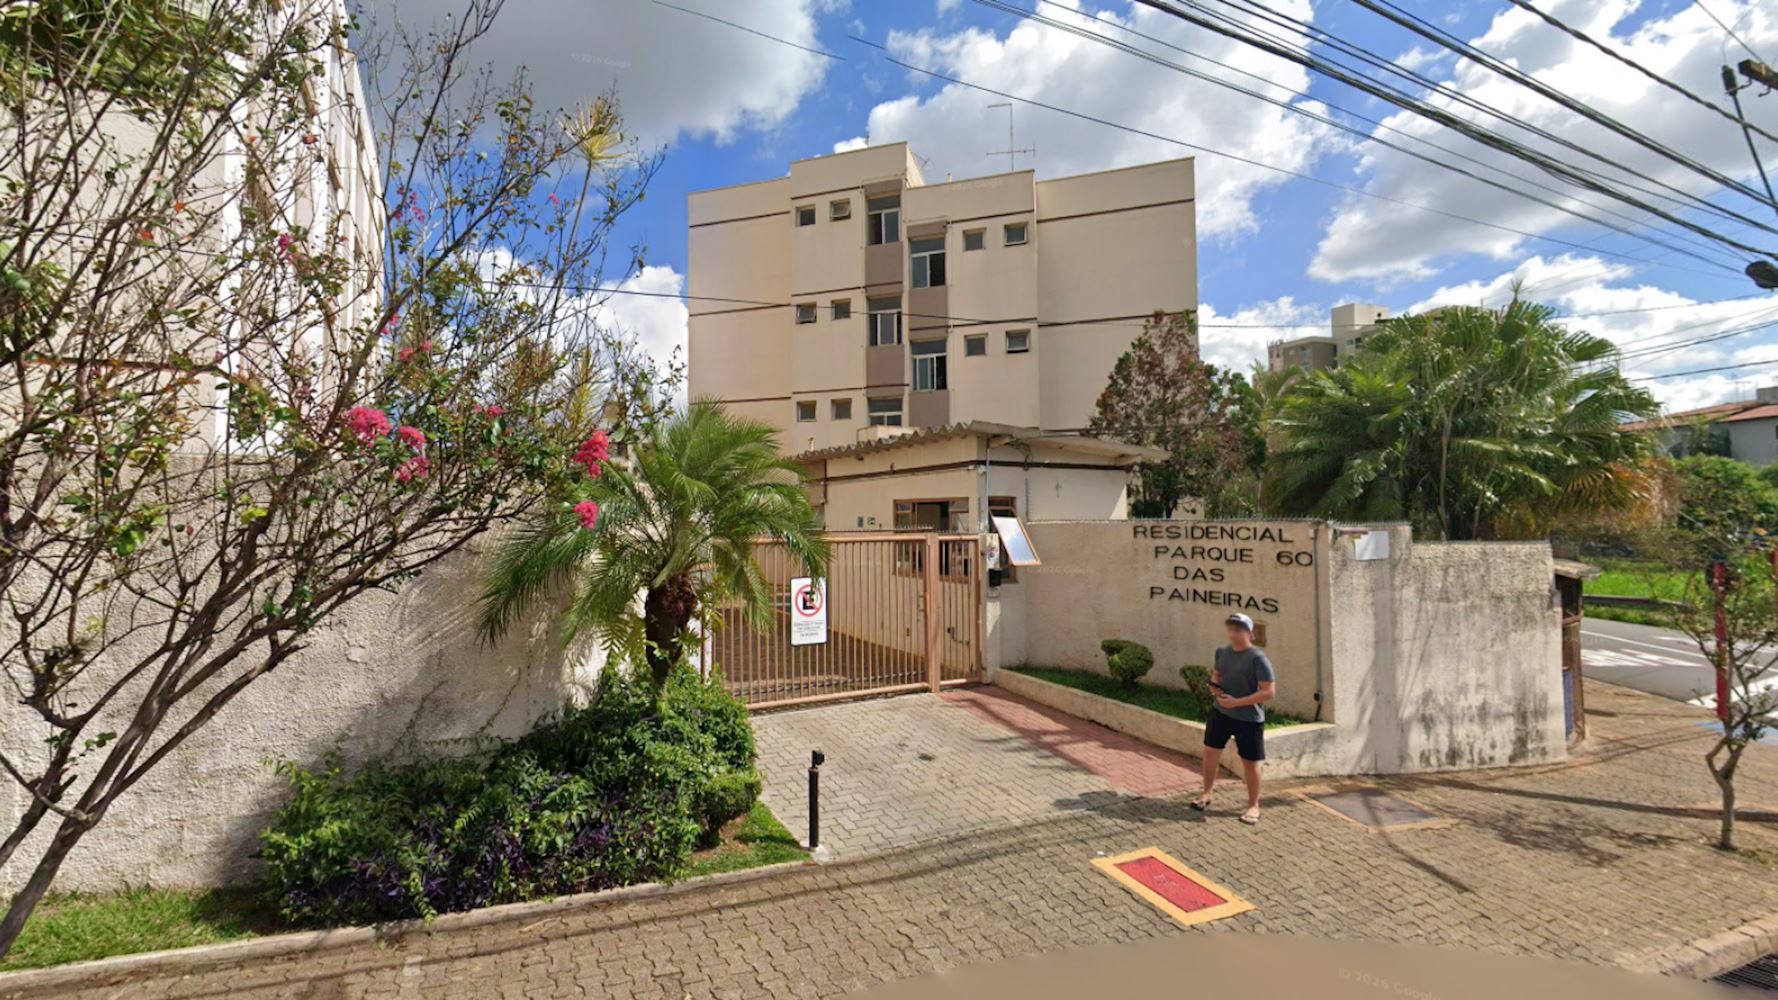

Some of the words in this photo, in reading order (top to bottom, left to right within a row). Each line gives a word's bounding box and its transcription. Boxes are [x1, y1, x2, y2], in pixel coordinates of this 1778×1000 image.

[1133, 525, 1294, 543] RESIDENCIAL
[1154, 546, 1254, 563] PARQUE
[1276, 550, 1313, 567] 60
[1174, 566, 1225, 582] DAS
[802, 591, 817, 609] E
[1150, 586, 1279, 614] PAINEIRAS
